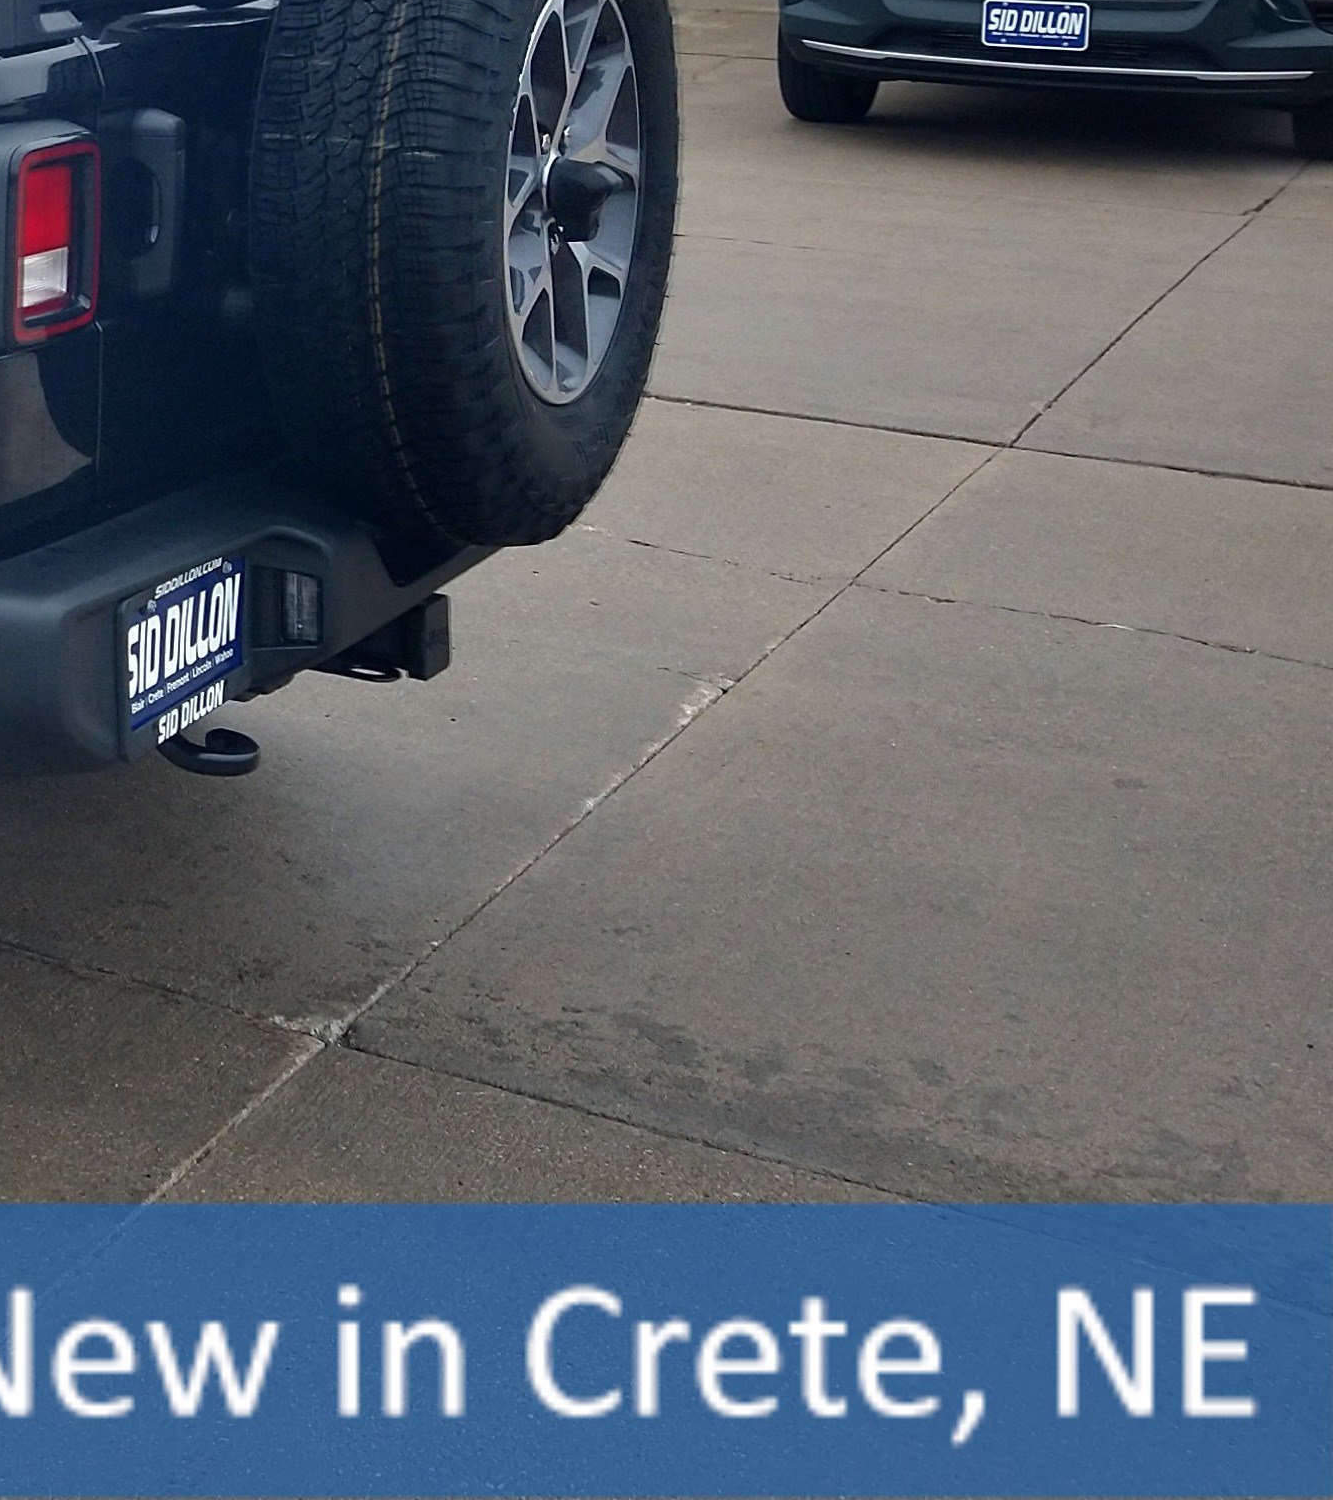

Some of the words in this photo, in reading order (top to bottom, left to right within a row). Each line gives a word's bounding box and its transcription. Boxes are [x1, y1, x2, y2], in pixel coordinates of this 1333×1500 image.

[987, 8, 1019, 32] SID
[1019, 10, 1085, 35] DILLON
[127, 614, 162, 698] SID
[164, 573, 241, 679] DILLON
[157, 707, 179, 745] SID
[180, 679, 225, 729] DILLON
